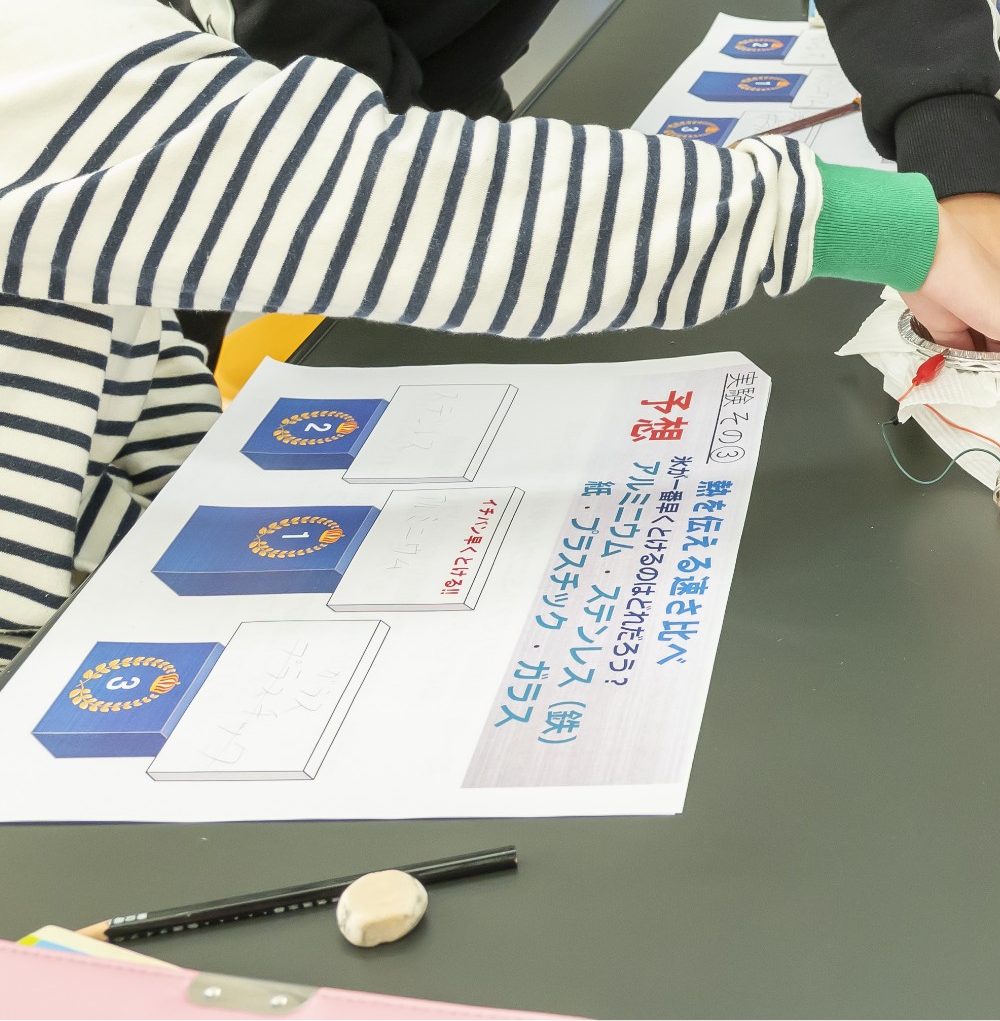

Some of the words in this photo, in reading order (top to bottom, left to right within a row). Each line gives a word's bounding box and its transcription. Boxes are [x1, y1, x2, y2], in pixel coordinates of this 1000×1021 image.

[630, 390, 693, 443] 予想
[304, 422, 332, 434] 2
[281, 531, 310, 540] 1
[656, 480, 734, 666] 熱を伝える速さ比べ
[106, 675, 141, 691] 3
